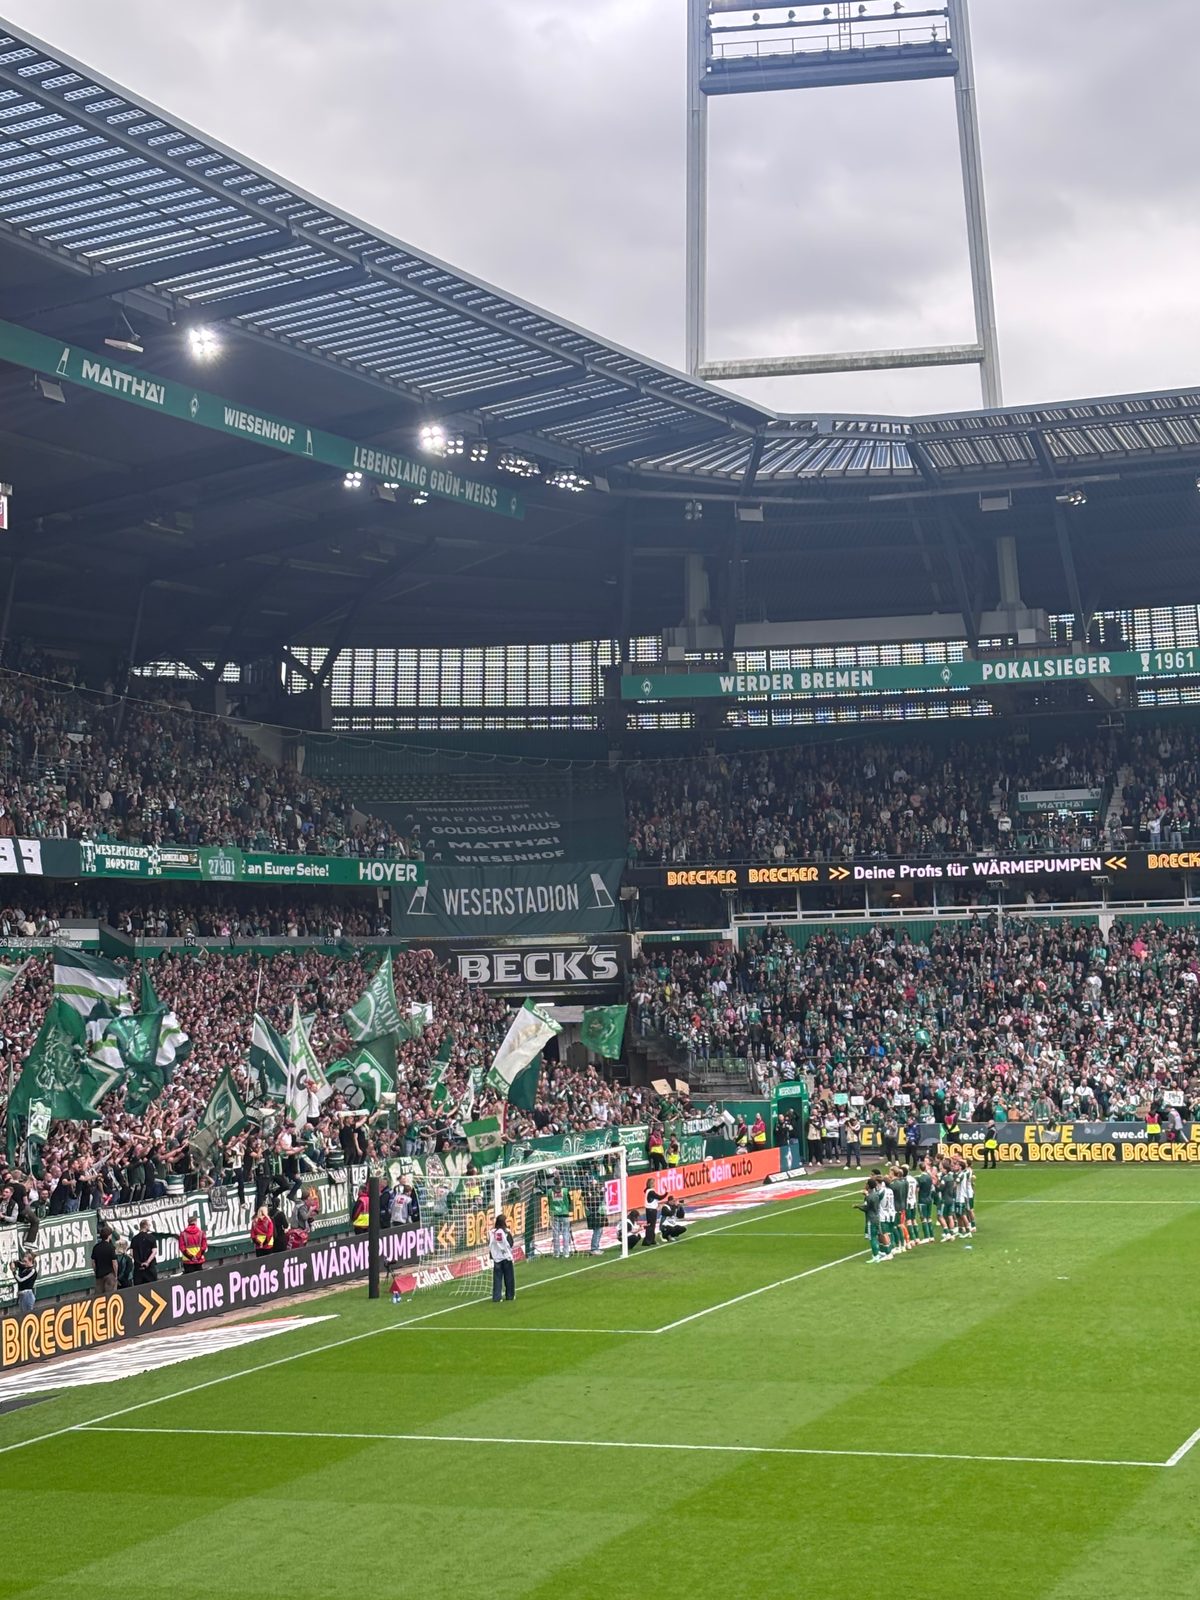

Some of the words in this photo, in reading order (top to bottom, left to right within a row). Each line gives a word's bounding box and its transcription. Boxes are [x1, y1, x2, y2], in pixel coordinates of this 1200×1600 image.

[82, 359, 165, 405] MATTHÄI
[224, 406, 295, 445] WIESENHOF
[353, 446, 427, 487] LEBENSLANG
[430, 470, 498, 508] GRÜN-WEISS
[982, 656, 1111, 680] POKALSIEGER
[1154, 651, 1195, 669] 1961
[719, 672, 794, 693] WERDER
[801, 669, 873, 690] BREMEN
[426, 814, 504, 823] HARALD
[511, 811, 555, 821] PIHL
[431, 820, 561, 835] GOLDSCHMAUS
[95, 844, 148, 858] WESERTIGERS
[454, 849, 566, 863] WIESENHOF
[105, 858, 140, 871] HOPSTEN
[247, 864, 262, 874] an
[264, 861, 295, 875] Eurer
[296, 863, 330, 876] Seite!
[359, 861, 417, 882] HOYER
[854, 865, 896, 880] Deine
[900, 864, 943, 878] Profis
[946, 862, 969, 877] für
[972, 857, 1102, 876] WÄRMEPUMPEN
[667, 869, 737, 886] BRECKER
[749, 867, 818, 883] BRECKER
[442, 883, 579, 916] WESERSTADION
[457, 945, 619, 984] BECK'S
[959, 1128, 986, 1140] e.de
[1027, 1142, 1116, 1161] BRECKER
[1121, 1142, 1200, 1161] BRECKE
[318, 1181, 349, 1215] TEAM
[172, 1279, 224, 1318] Deine
[229, 1264, 278, 1304] Profis
[283, 1256, 308, 1288] für
[412, 1265, 455, 1289] Zillertal
[2, 1293, 125, 1366] BRECKER
